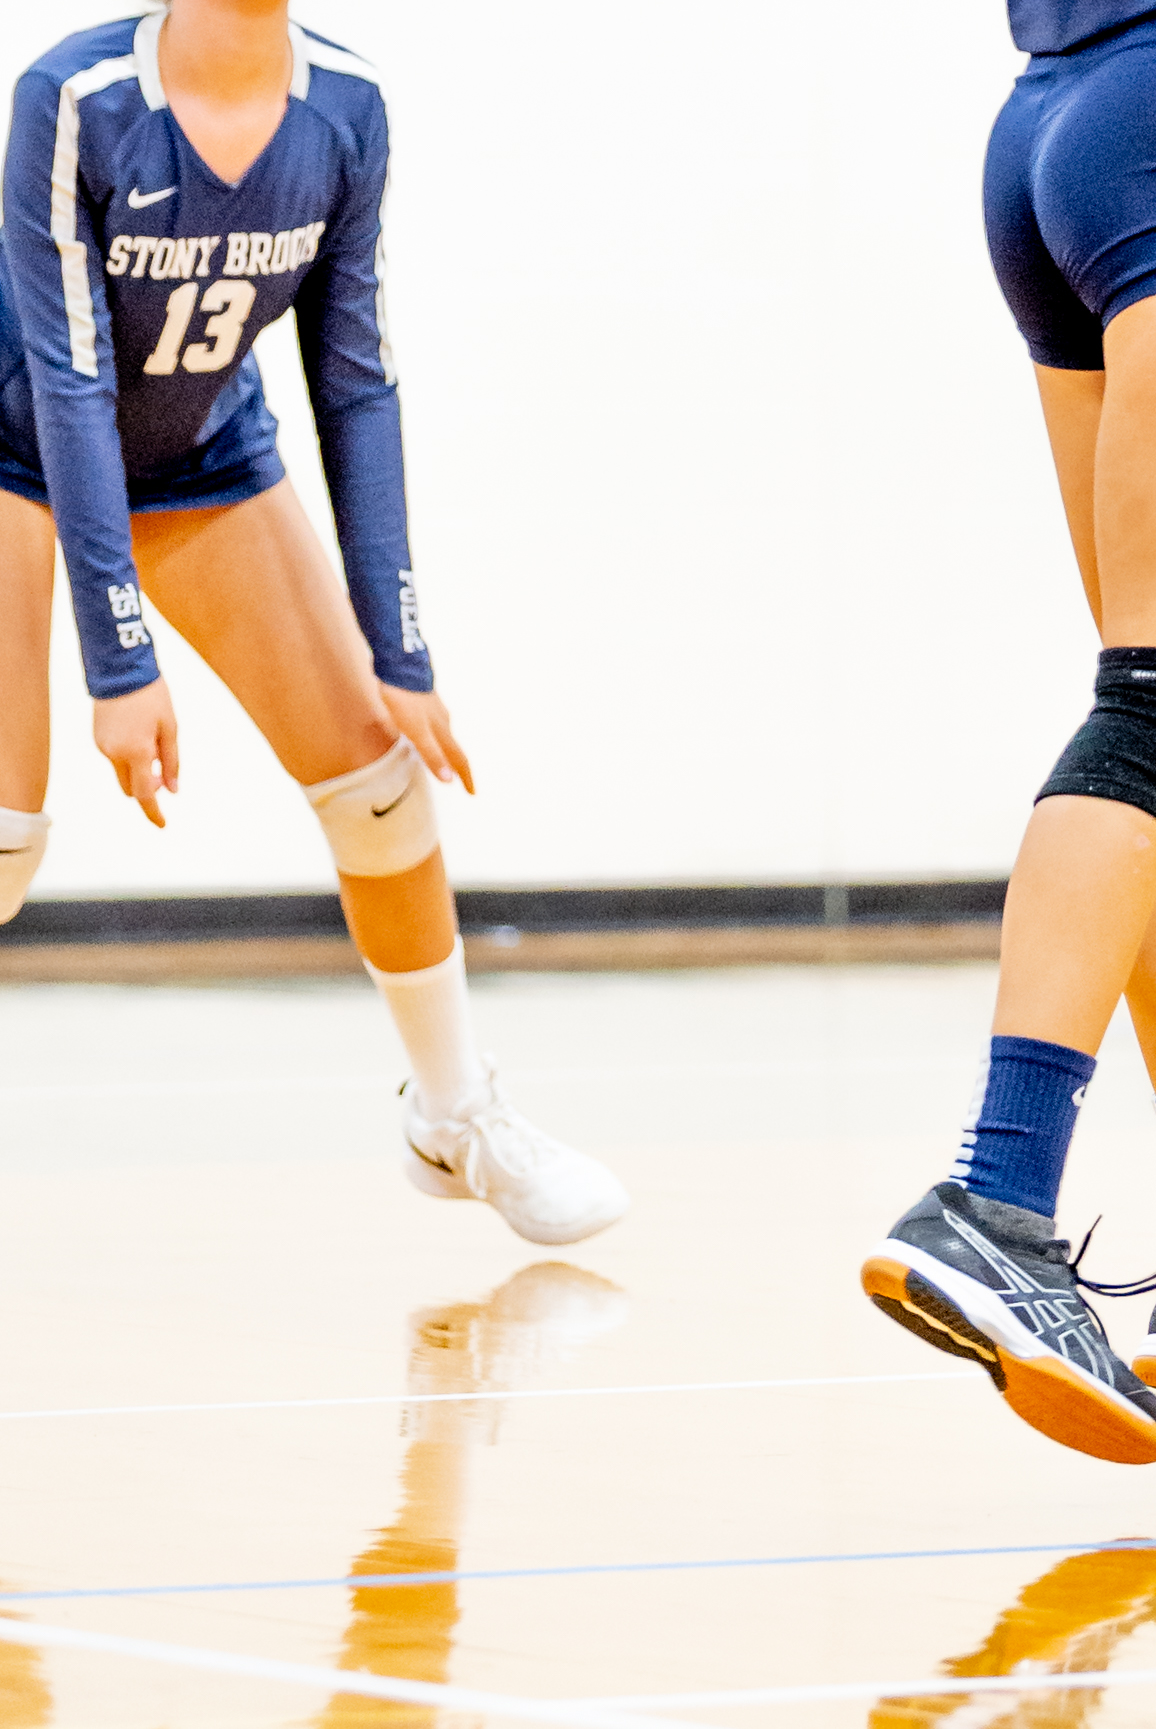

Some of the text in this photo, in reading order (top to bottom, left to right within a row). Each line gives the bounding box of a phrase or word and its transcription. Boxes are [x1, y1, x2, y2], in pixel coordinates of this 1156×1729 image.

[106, 220, 327, 281] STONY BROOK
[143, 279, 257, 376] 13
